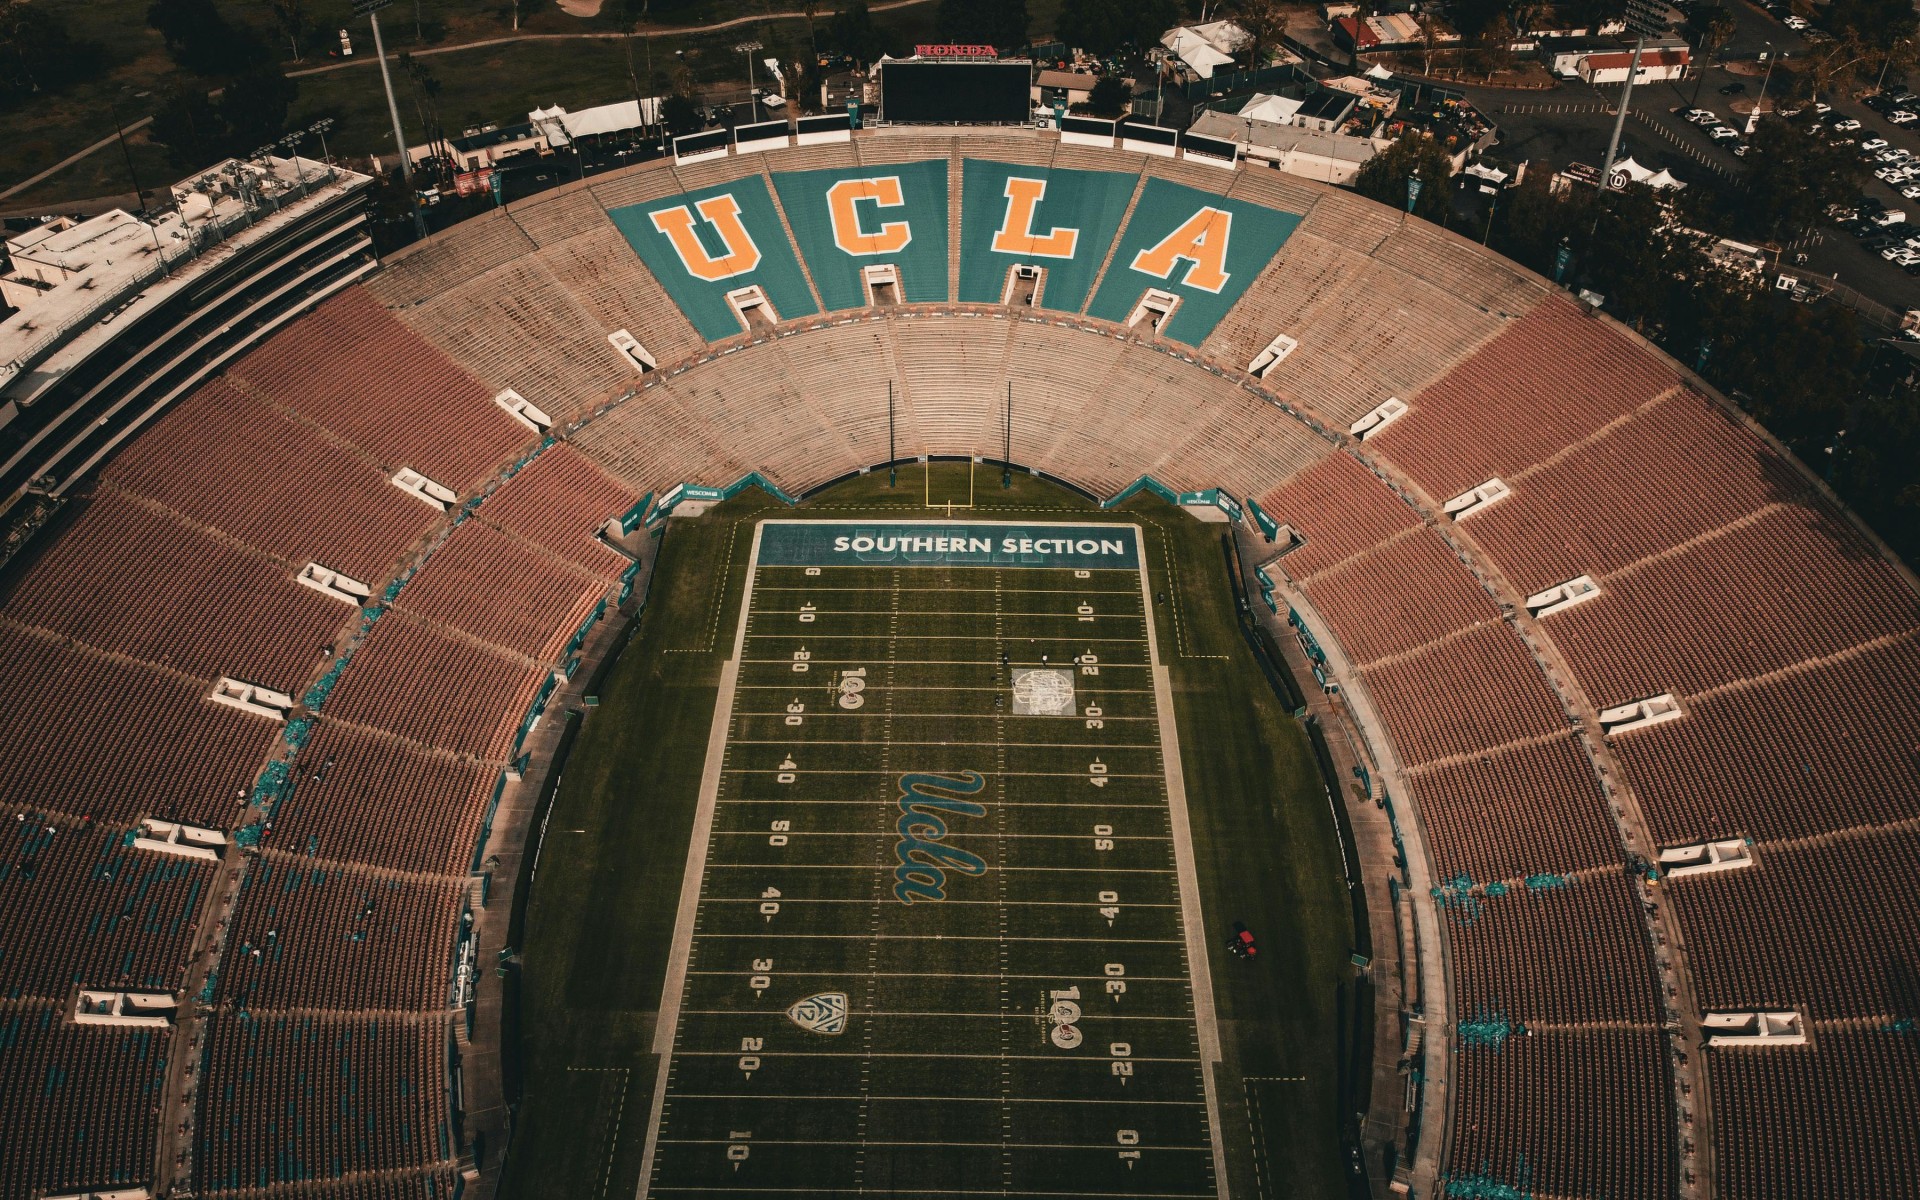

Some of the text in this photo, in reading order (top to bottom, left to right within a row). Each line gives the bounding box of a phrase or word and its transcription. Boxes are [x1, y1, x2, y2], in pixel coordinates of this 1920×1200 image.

[915, 44, 998, 56] HONDA
[648, 175, 1235, 295] UCLA
[686, 489, 713, 497] WESCOM
[834, 537, 1124, 556] SOUTHERN SECTION
[799, 606, 817, 623] 10
[1077, 605, 1095, 622] 10
[792, 651, 811, 672] 20
[1081, 654, 1099, 676] 20
[785, 703, 805, 726] 30
[1085, 706, 1104, 729] 30
[777, 759, 797, 784] 40
[1089, 763, 1108, 788] 40
[769, 820, 790, 846] 50
[1094, 824, 1114, 851] 50
[760, 886, 782, 915] 40
[1099, 890, 1120, 919] 40
[750, 958, 773, 989] 30
[1104, 963, 1127, 994] 30
[797, 1004, 816, 1021] 12
[1050, 985, 1083, 1050] 100
[738, 1037, 764, 1071] 20
[1110, 1042, 1133, 1076] 20
[727, 1131, 752, 1161] 10
[1116, 1130, 1141, 1159] 10
